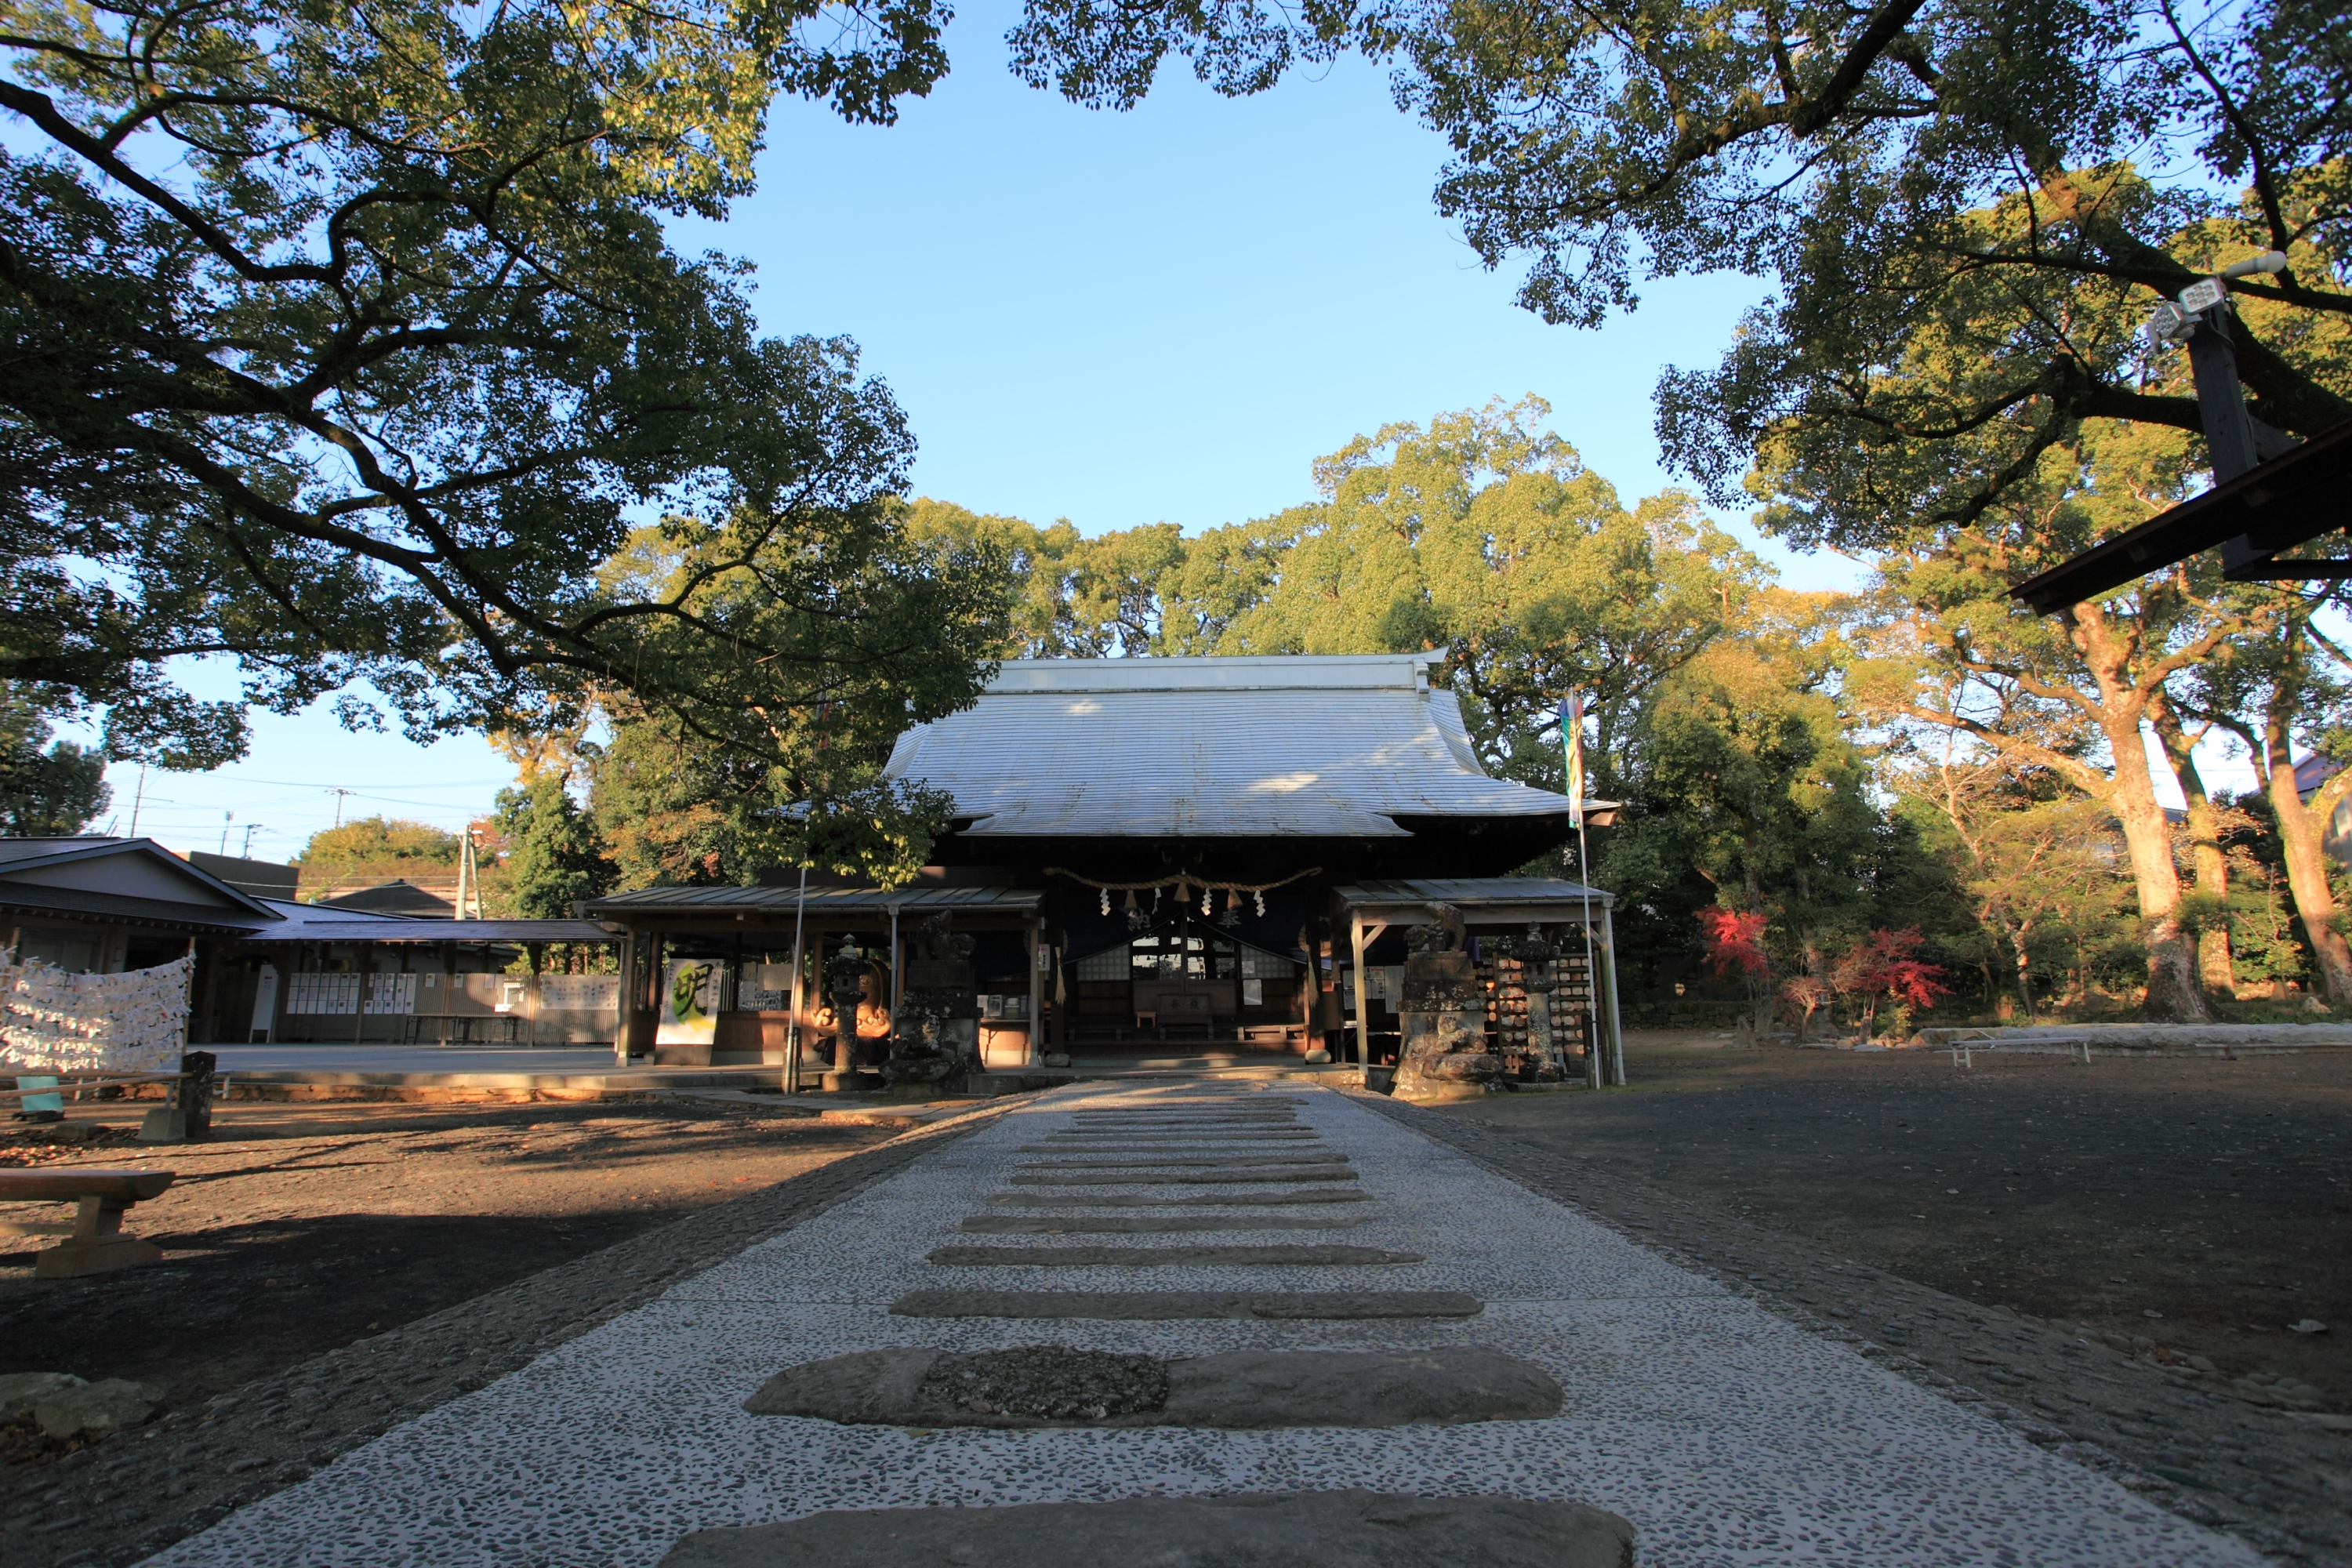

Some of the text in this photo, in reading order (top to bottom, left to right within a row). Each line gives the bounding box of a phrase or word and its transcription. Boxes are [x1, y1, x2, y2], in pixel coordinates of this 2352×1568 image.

[1127, 907, 1241, 932] 奉 納
[673, 964, 714, 1017] 明
